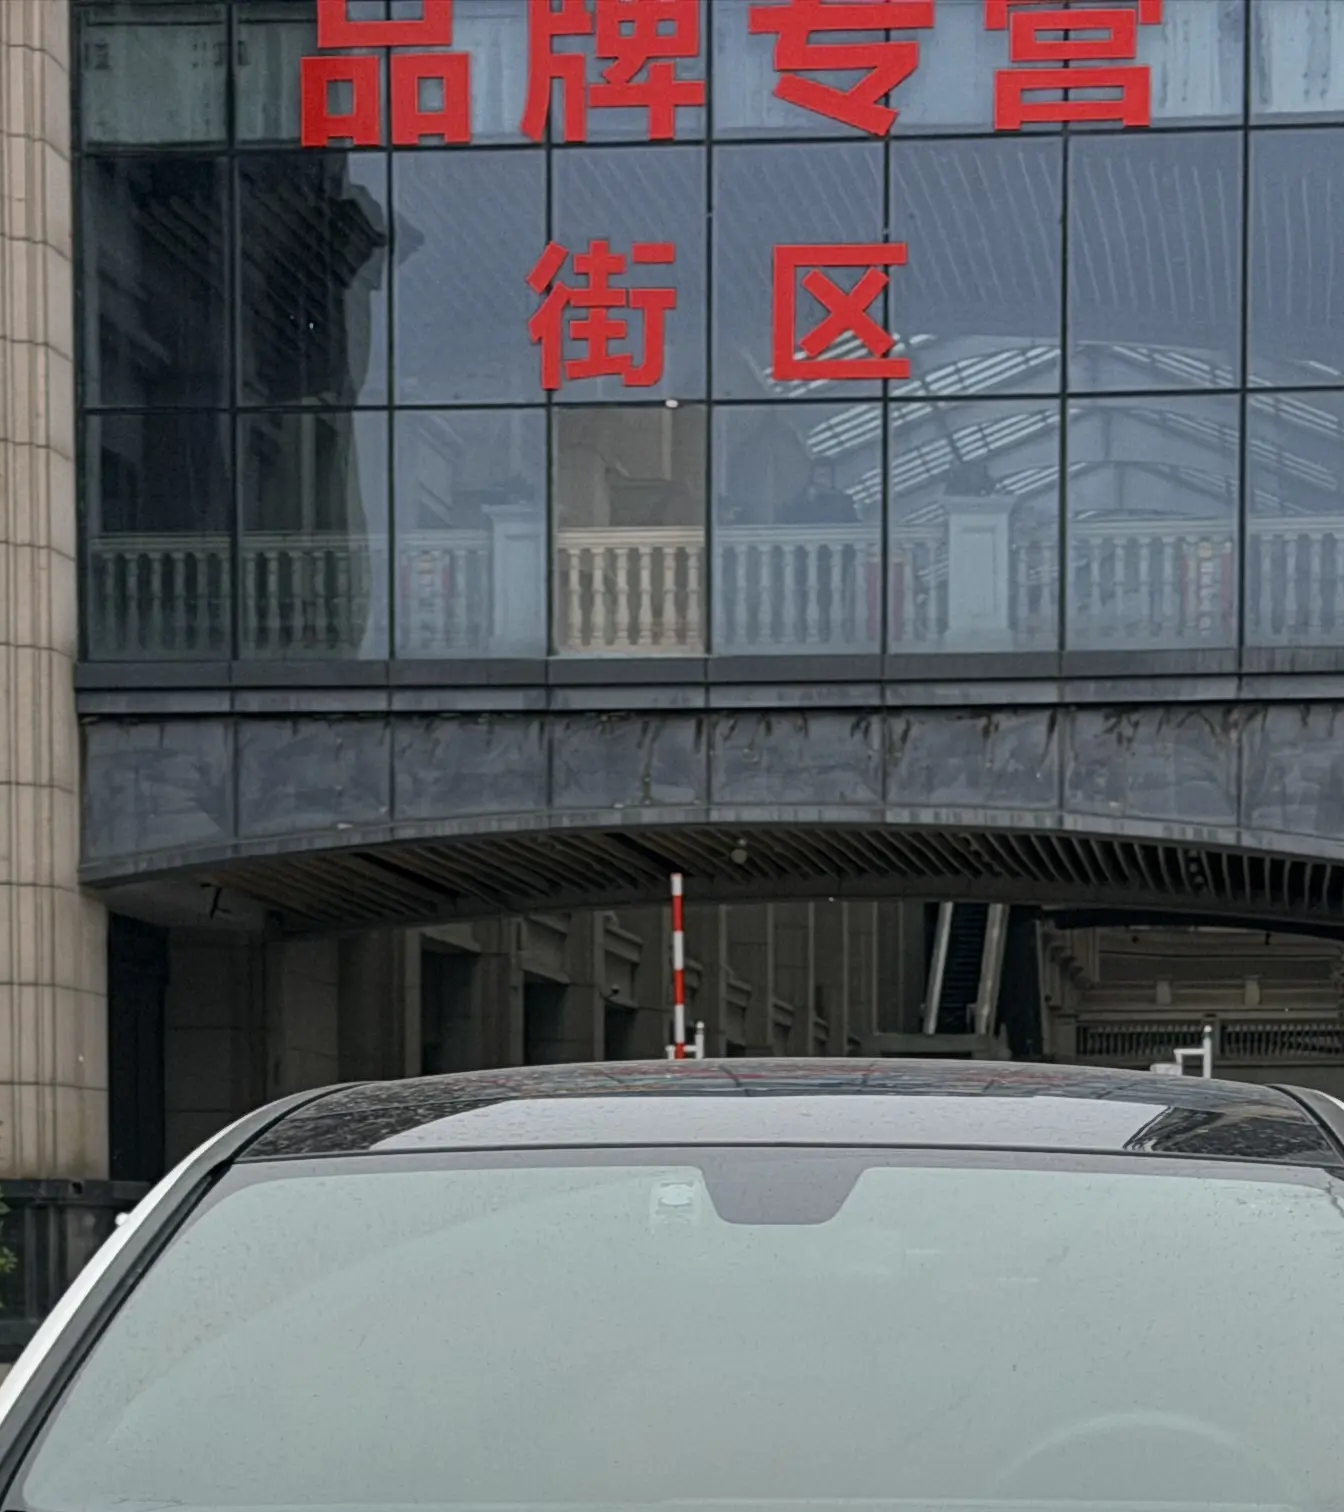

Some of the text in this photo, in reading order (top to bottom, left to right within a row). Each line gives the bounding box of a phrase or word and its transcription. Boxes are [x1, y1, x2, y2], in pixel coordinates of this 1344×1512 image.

[301, 0, 1163, 147] 品牌专营
[526, 240, 911, 390] 街区
